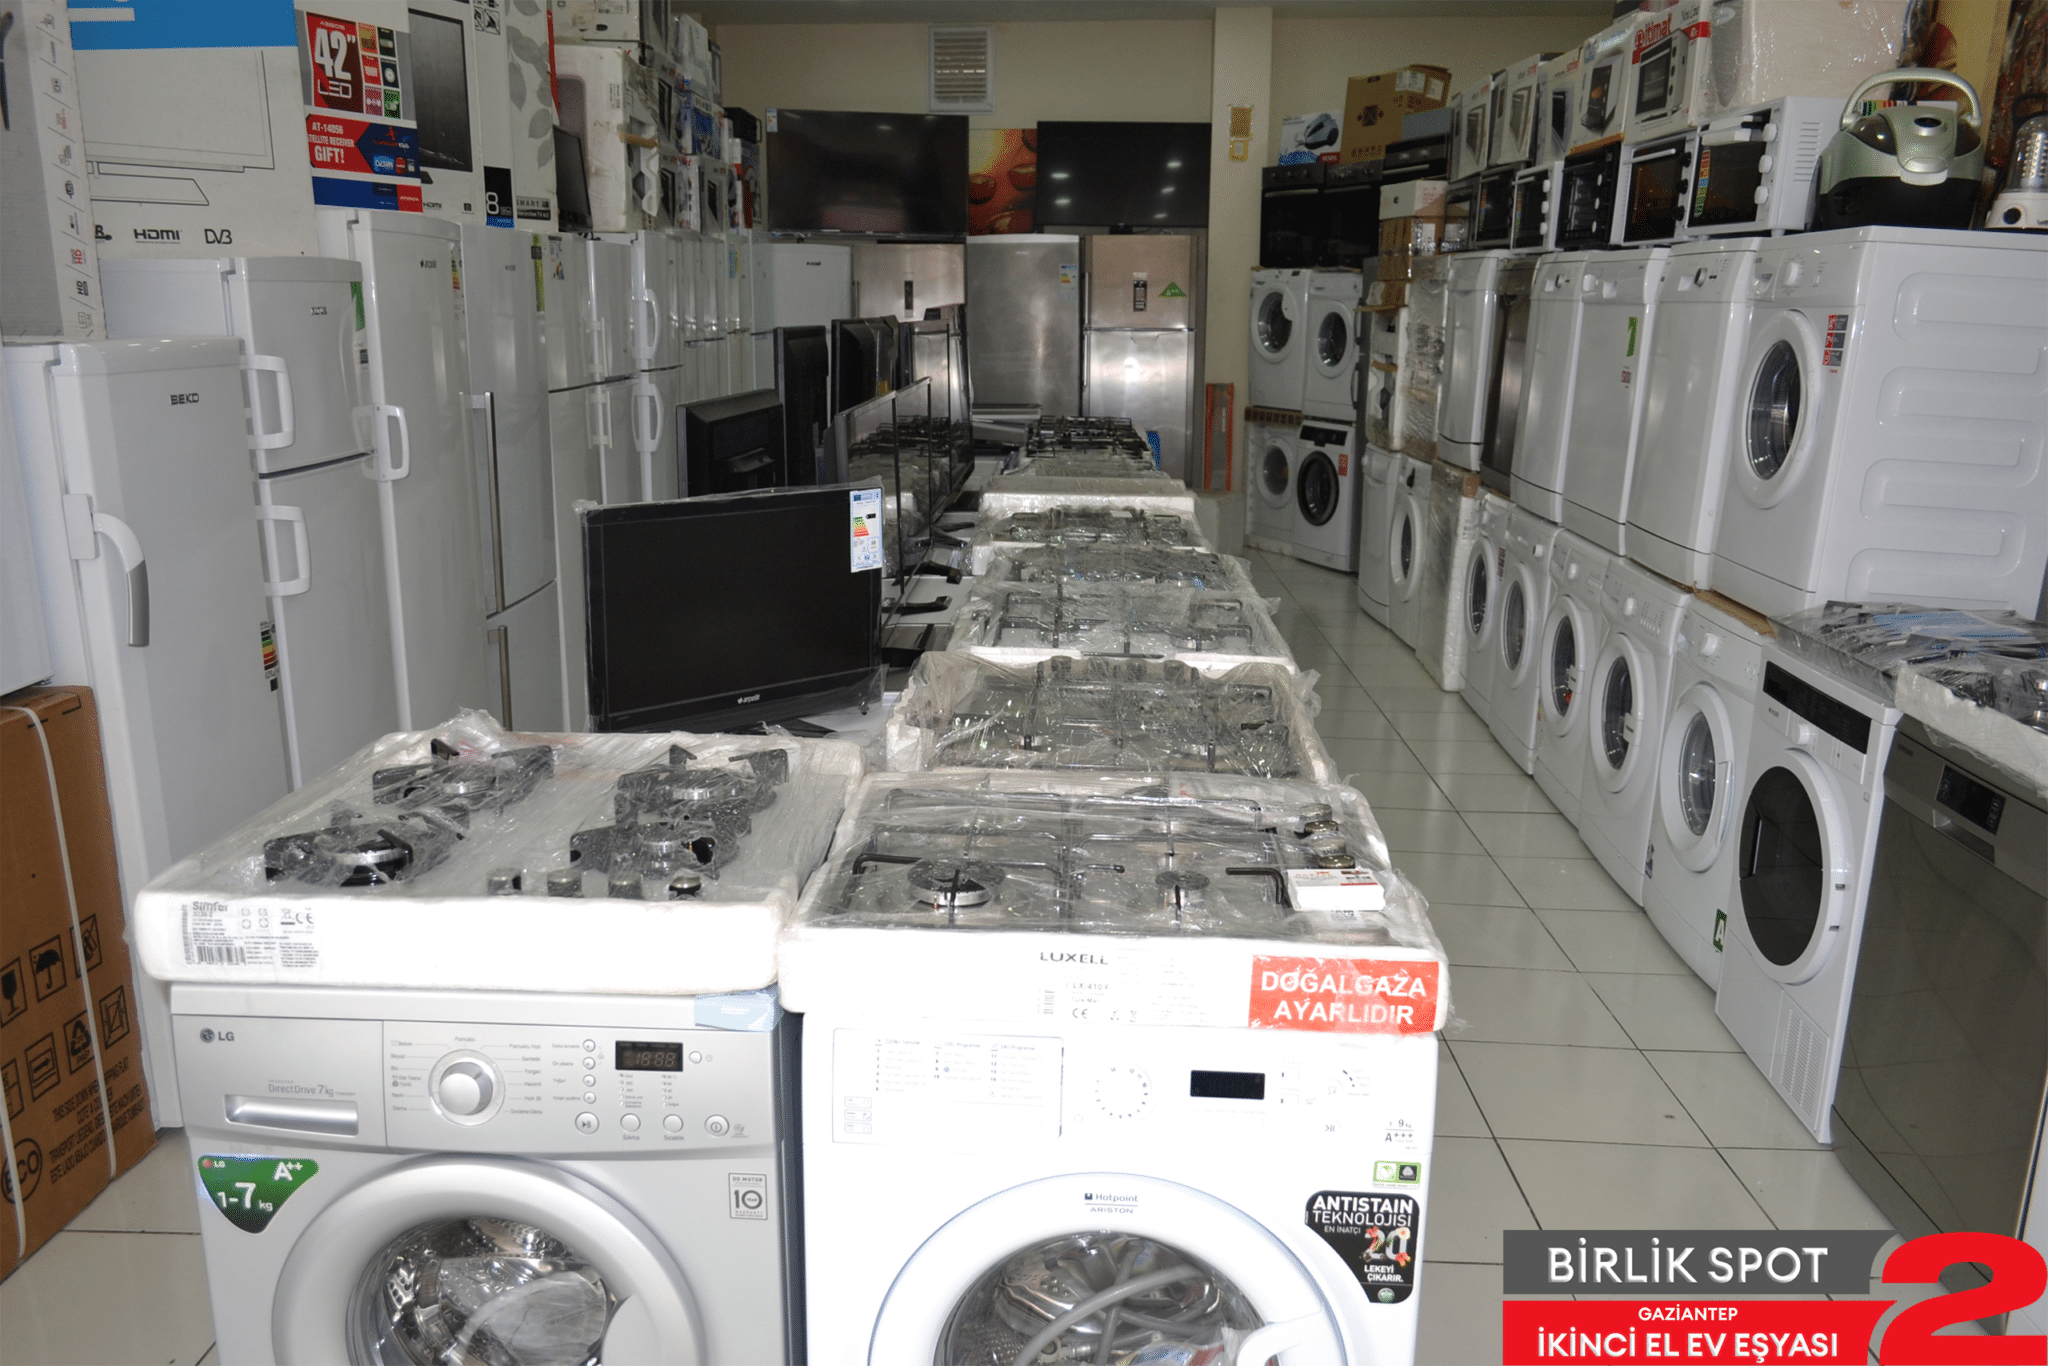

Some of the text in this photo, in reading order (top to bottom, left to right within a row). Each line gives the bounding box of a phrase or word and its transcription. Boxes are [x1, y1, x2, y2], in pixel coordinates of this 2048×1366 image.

[318, 79, 352, 98] LED
[314, 145, 345, 164] GIFT!
[134, 228, 180, 240] HDMI
[204, 228, 232, 244] DVB
[170, 392, 200, 405] BEKO
[1715, 919, 1725, 945] A
[1040, 952, 1108, 966] LUXELL
[1262, 968, 1427, 998] DOĞALGAZA
[1274, 1000, 1414, 1024] AYARLIDIR
[218, 1031, 235, 1042] LG
[274, 1161, 302, 1182] A++
[218, 1181, 274, 1212] 1-7 kg
[734, 1190, 763, 1210] 10
[1096, 1194, 1138, 1202] Hotpoint
[1312, 1194, 1414, 1214] ANTISTAIN
[1324, 1225, 1336, 1233] EN
[1362, 1226, 1412, 1263] 20
[1364, 1264, 1394, 1274] LEKEYİ
